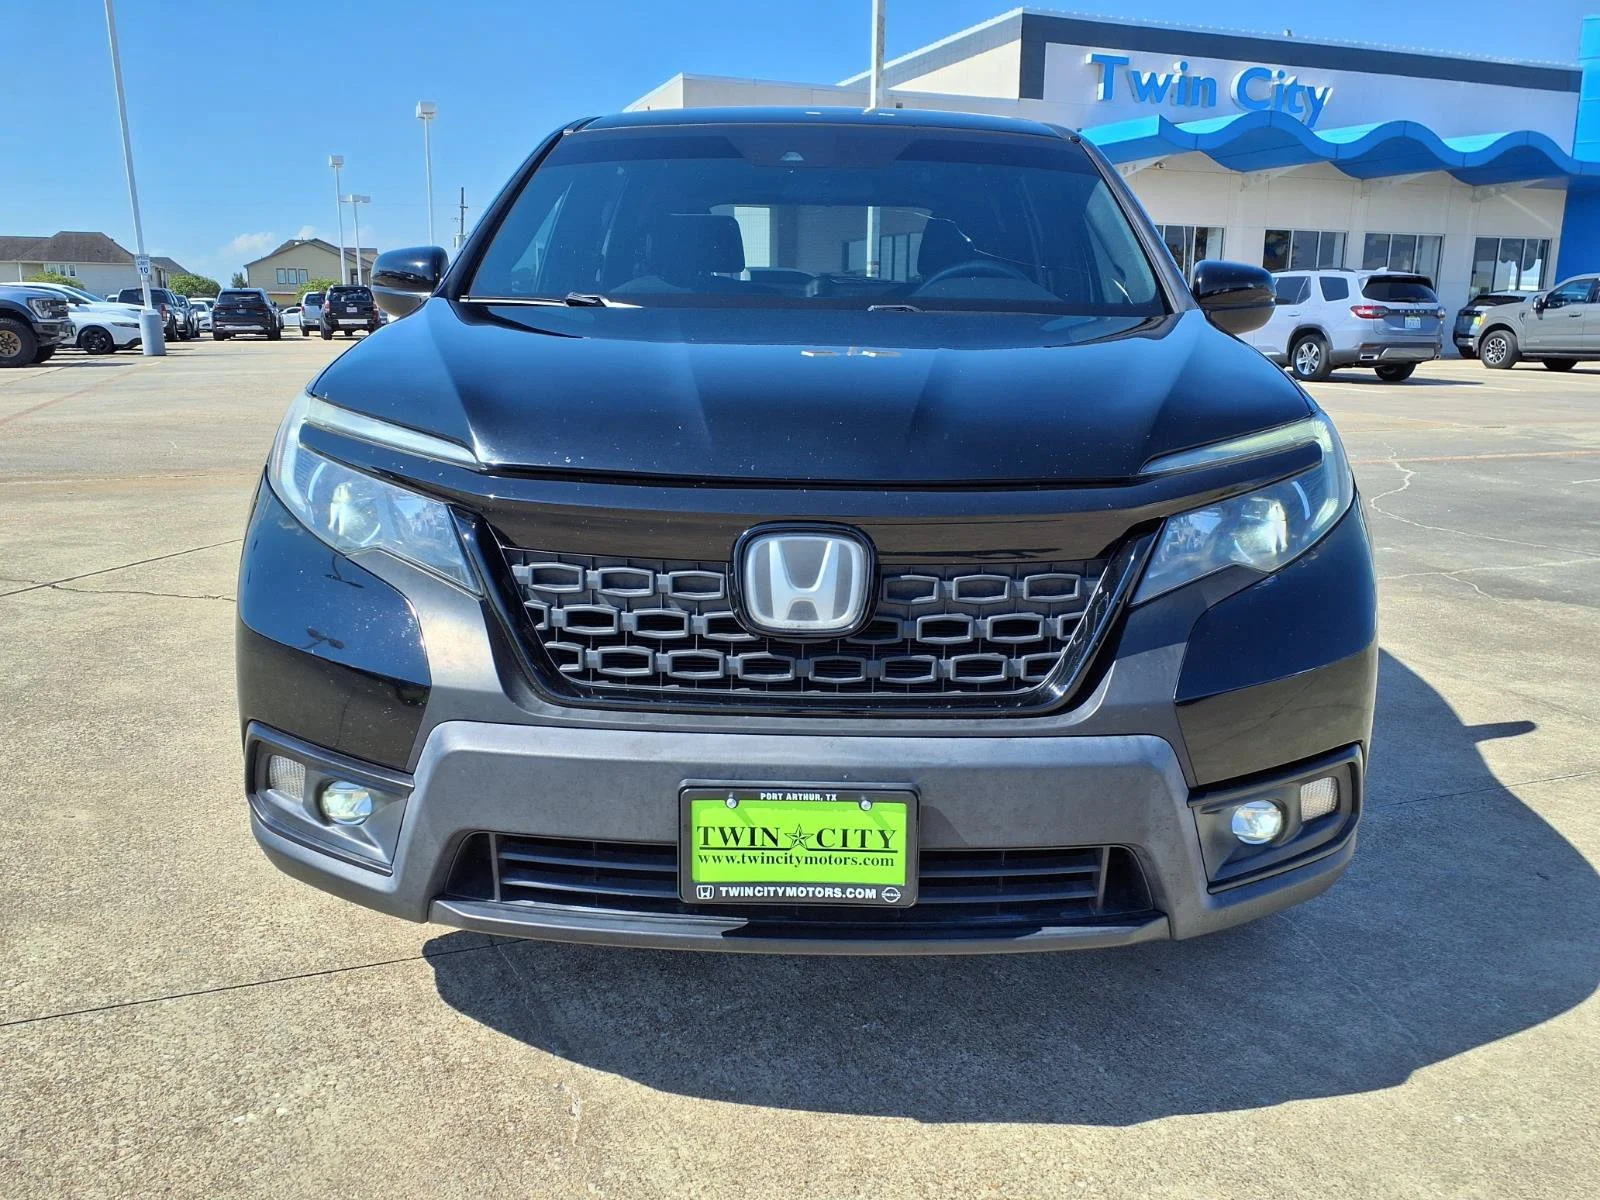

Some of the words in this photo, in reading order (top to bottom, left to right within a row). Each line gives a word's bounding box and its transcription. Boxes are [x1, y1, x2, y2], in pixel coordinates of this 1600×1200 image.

[1086, 53, 1217, 107] Twin
[1231, 66, 1334, 128] City
[760, 792, 783, 801] PORT
[785, 793, 823, 802] ARTHUR,
[825, 794, 837, 802] TX
[697, 825, 780, 848] TWIN
[816, 828, 896, 849] CITY
[698, 852, 895, 868] www.twincitymotors.com
[719, 886, 877, 899] TWINCITYMOTORS.COM
